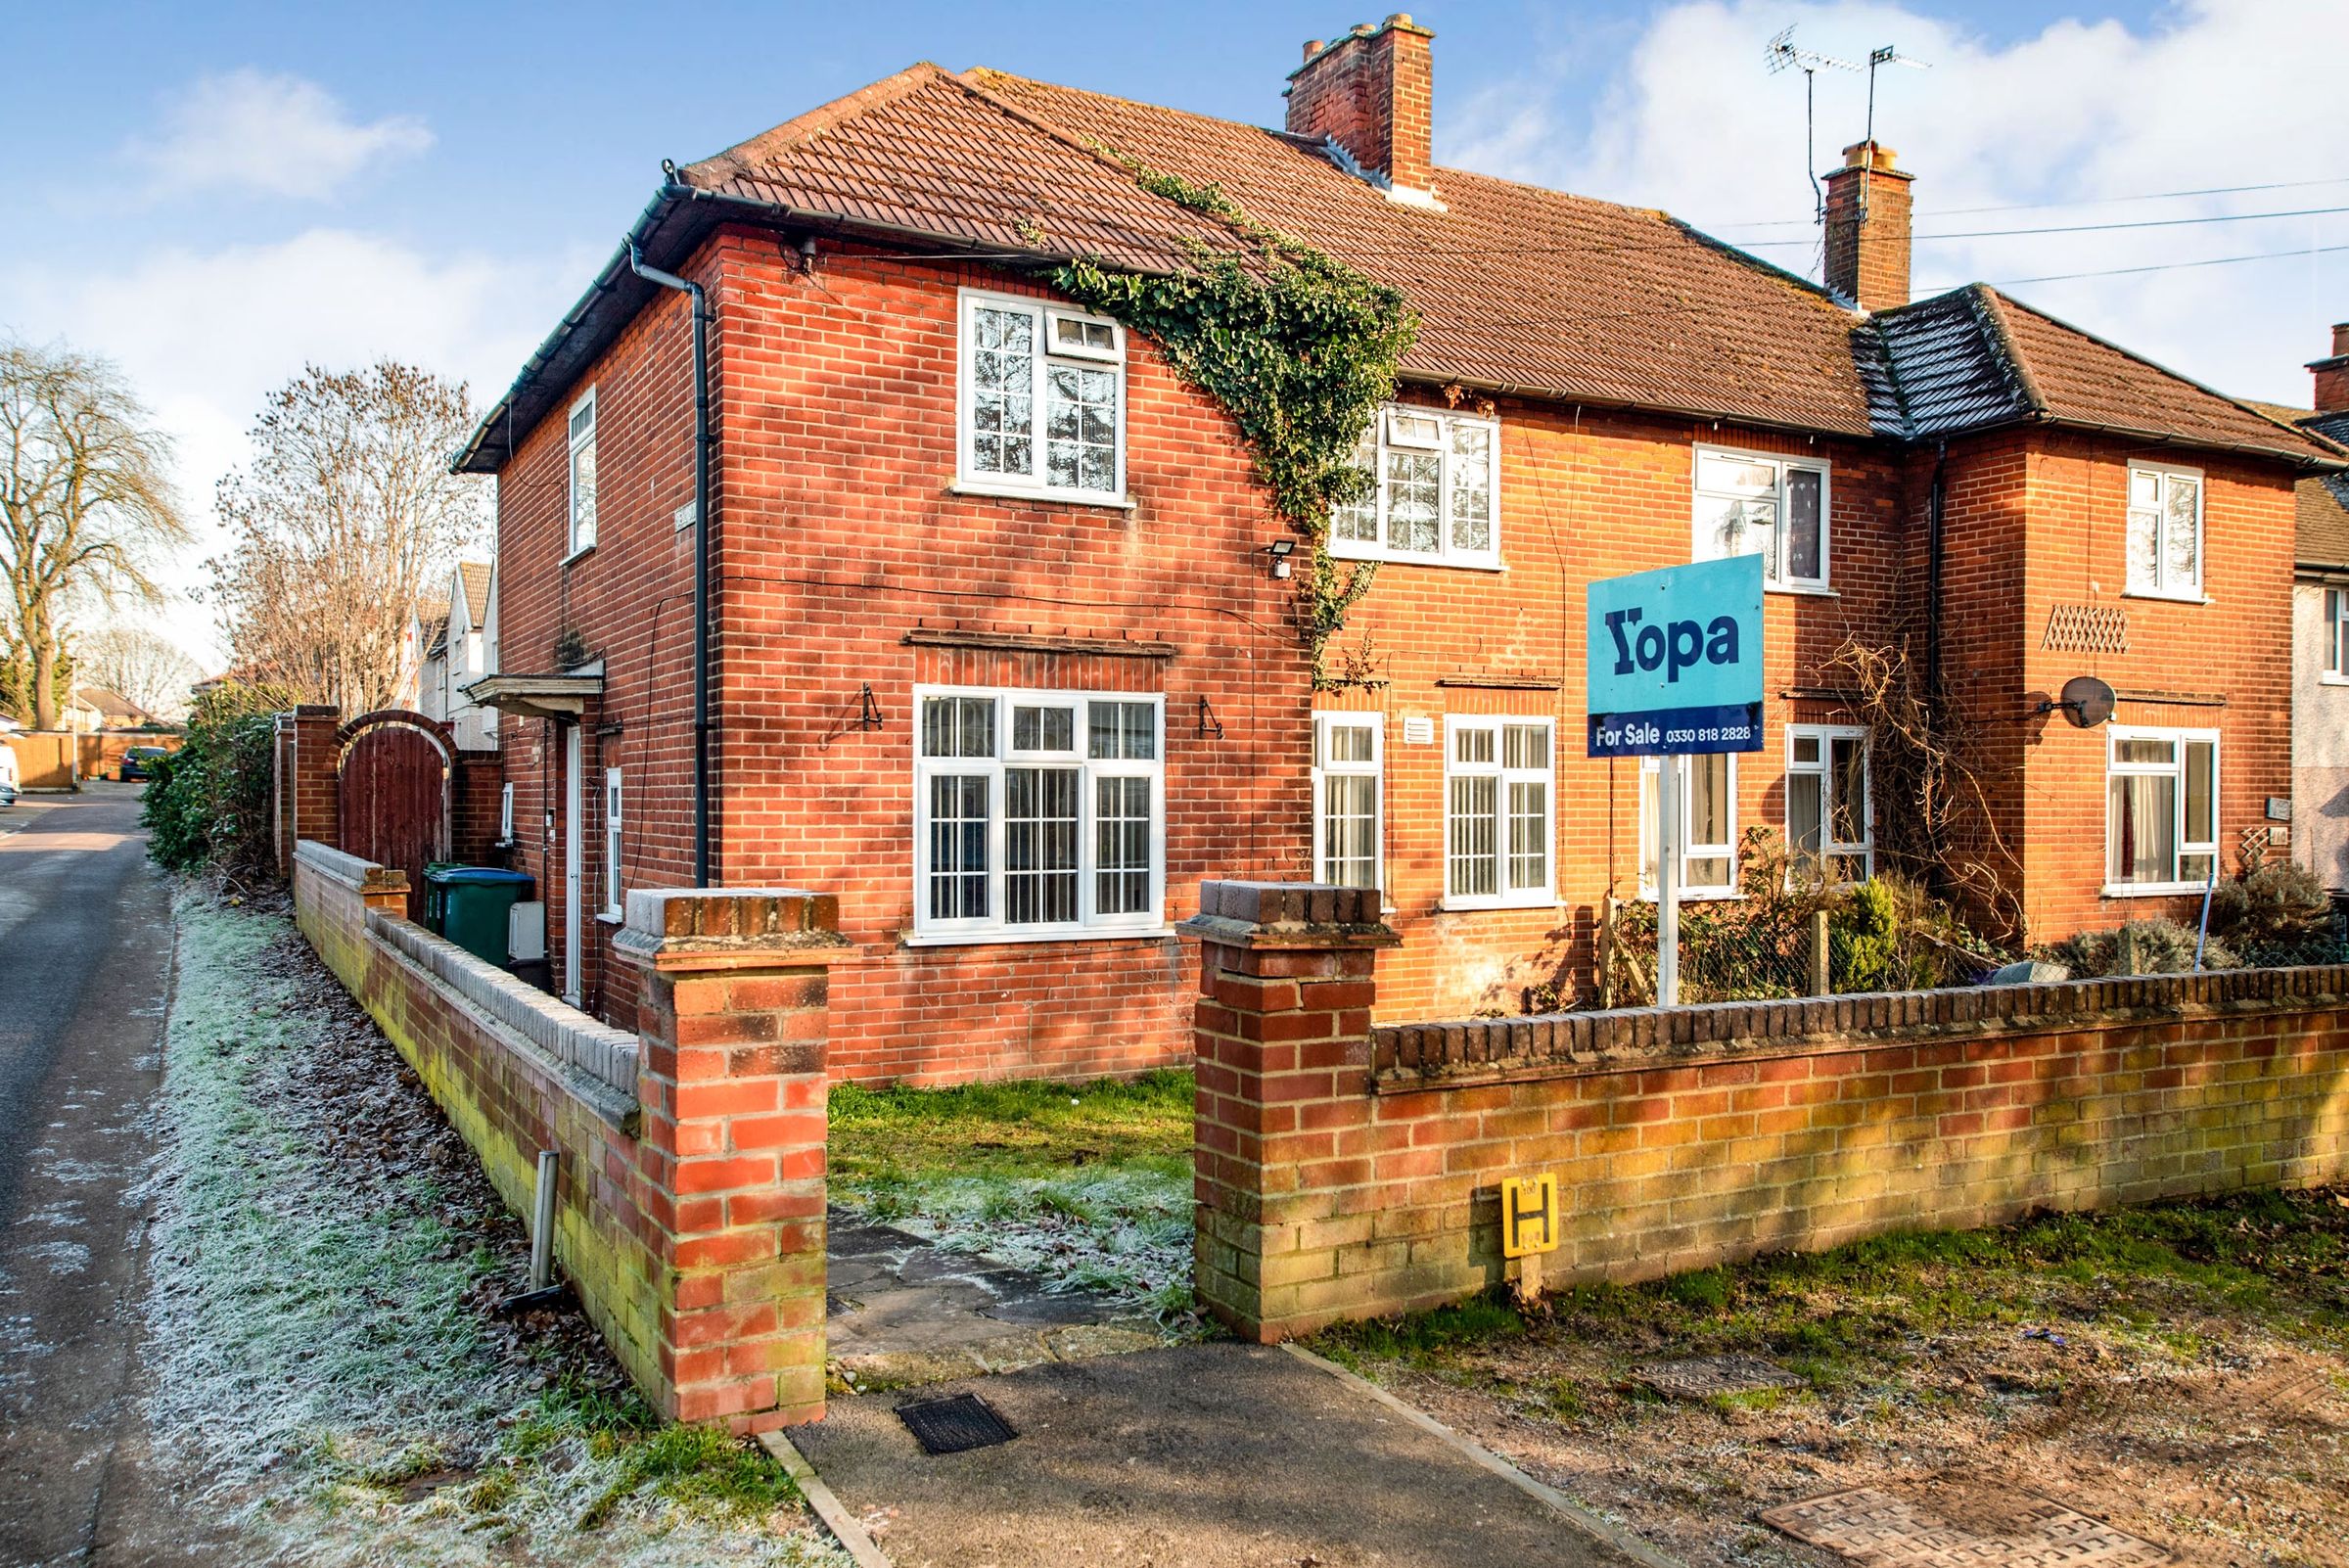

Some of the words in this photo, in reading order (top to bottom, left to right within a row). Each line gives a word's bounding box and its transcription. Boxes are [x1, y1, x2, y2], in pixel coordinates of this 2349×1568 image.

[1605, 607, 1739, 683] Yopa
[1596, 726, 1622, 747] For
[1625, 722, 1660, 745] Sale
[1666, 729, 1695, 743] 0330
[1698, 728, 1718, 741] 818
[1721, 726, 1751, 741] 2828
[1511, 1182, 1549, 1248] H
